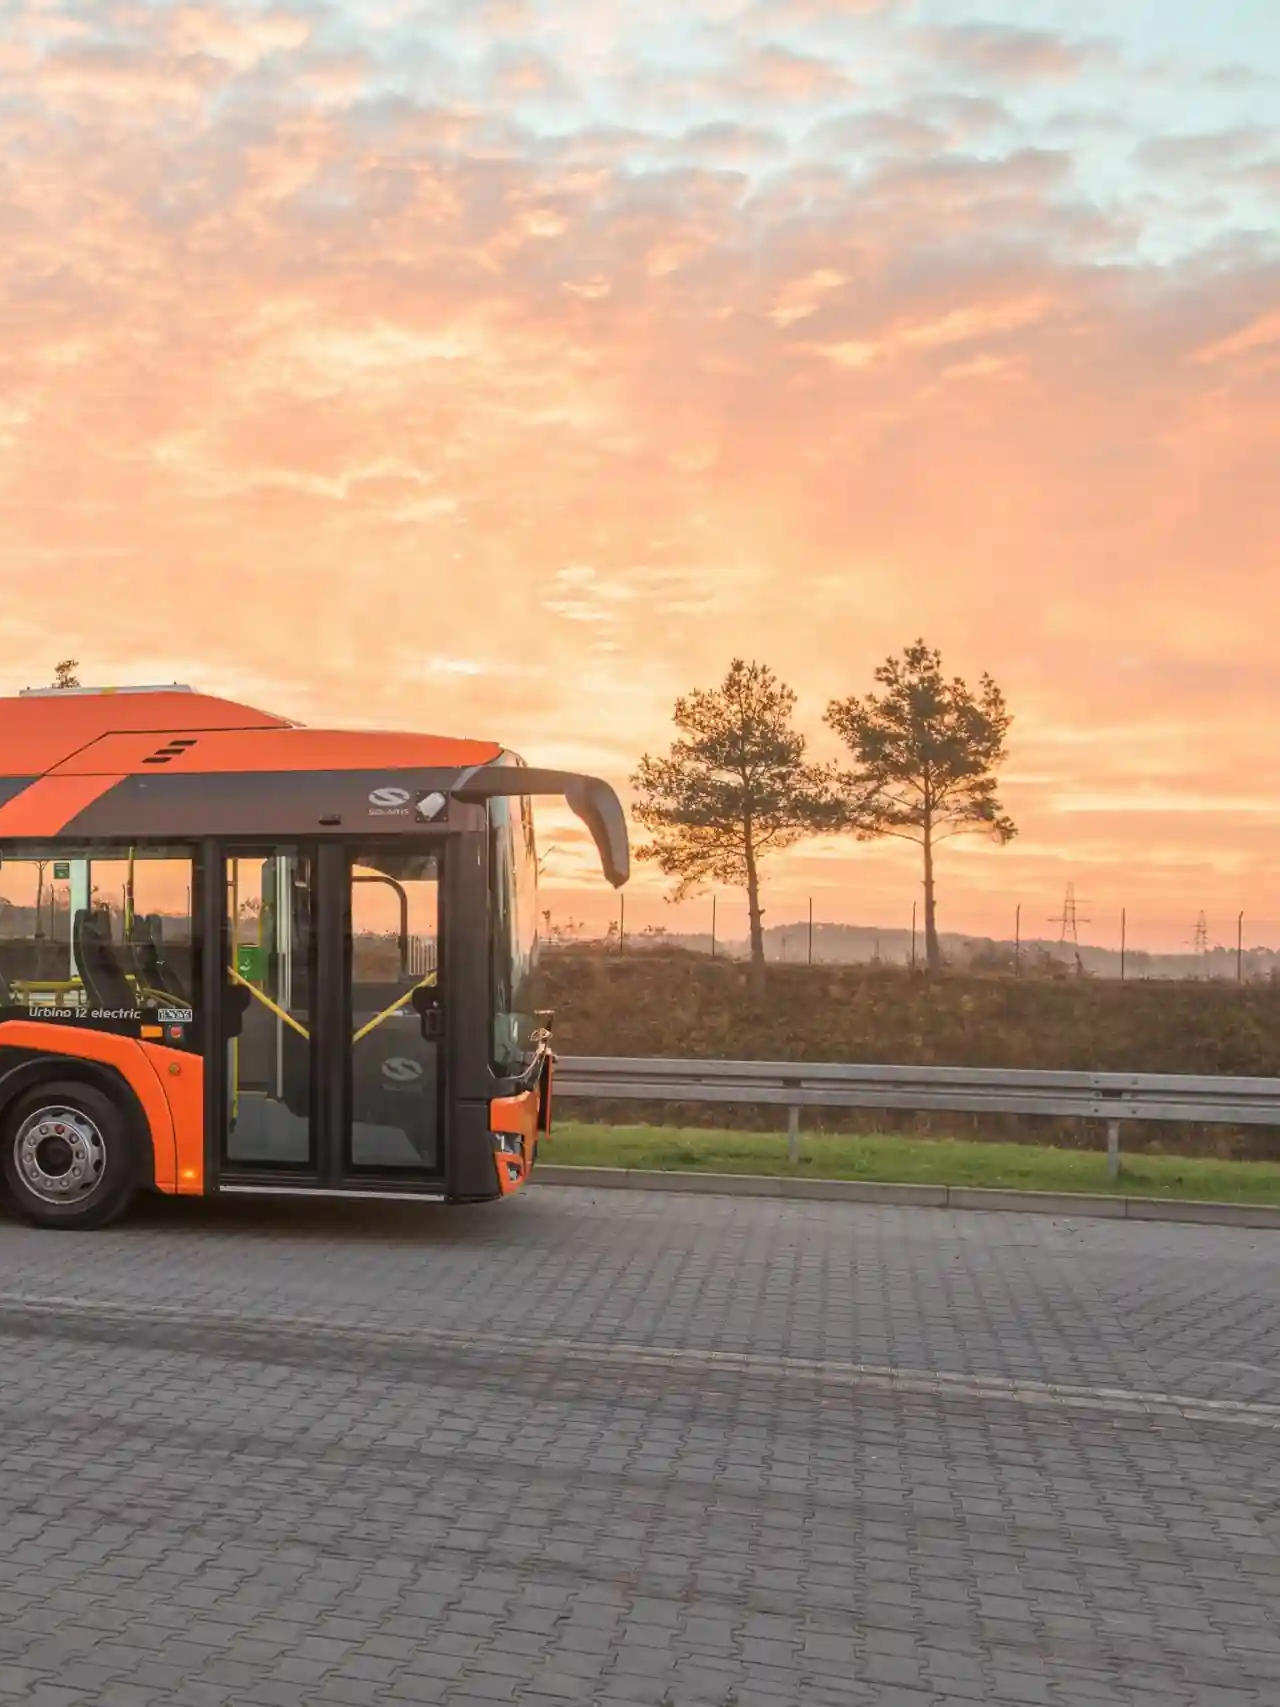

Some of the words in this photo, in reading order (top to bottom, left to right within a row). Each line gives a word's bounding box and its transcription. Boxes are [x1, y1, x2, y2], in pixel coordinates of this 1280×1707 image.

[29, 1006, 71, 1018] Urbino
[75, 1007, 87, 1019] 12
[91, 1007, 142, 1020] electric
